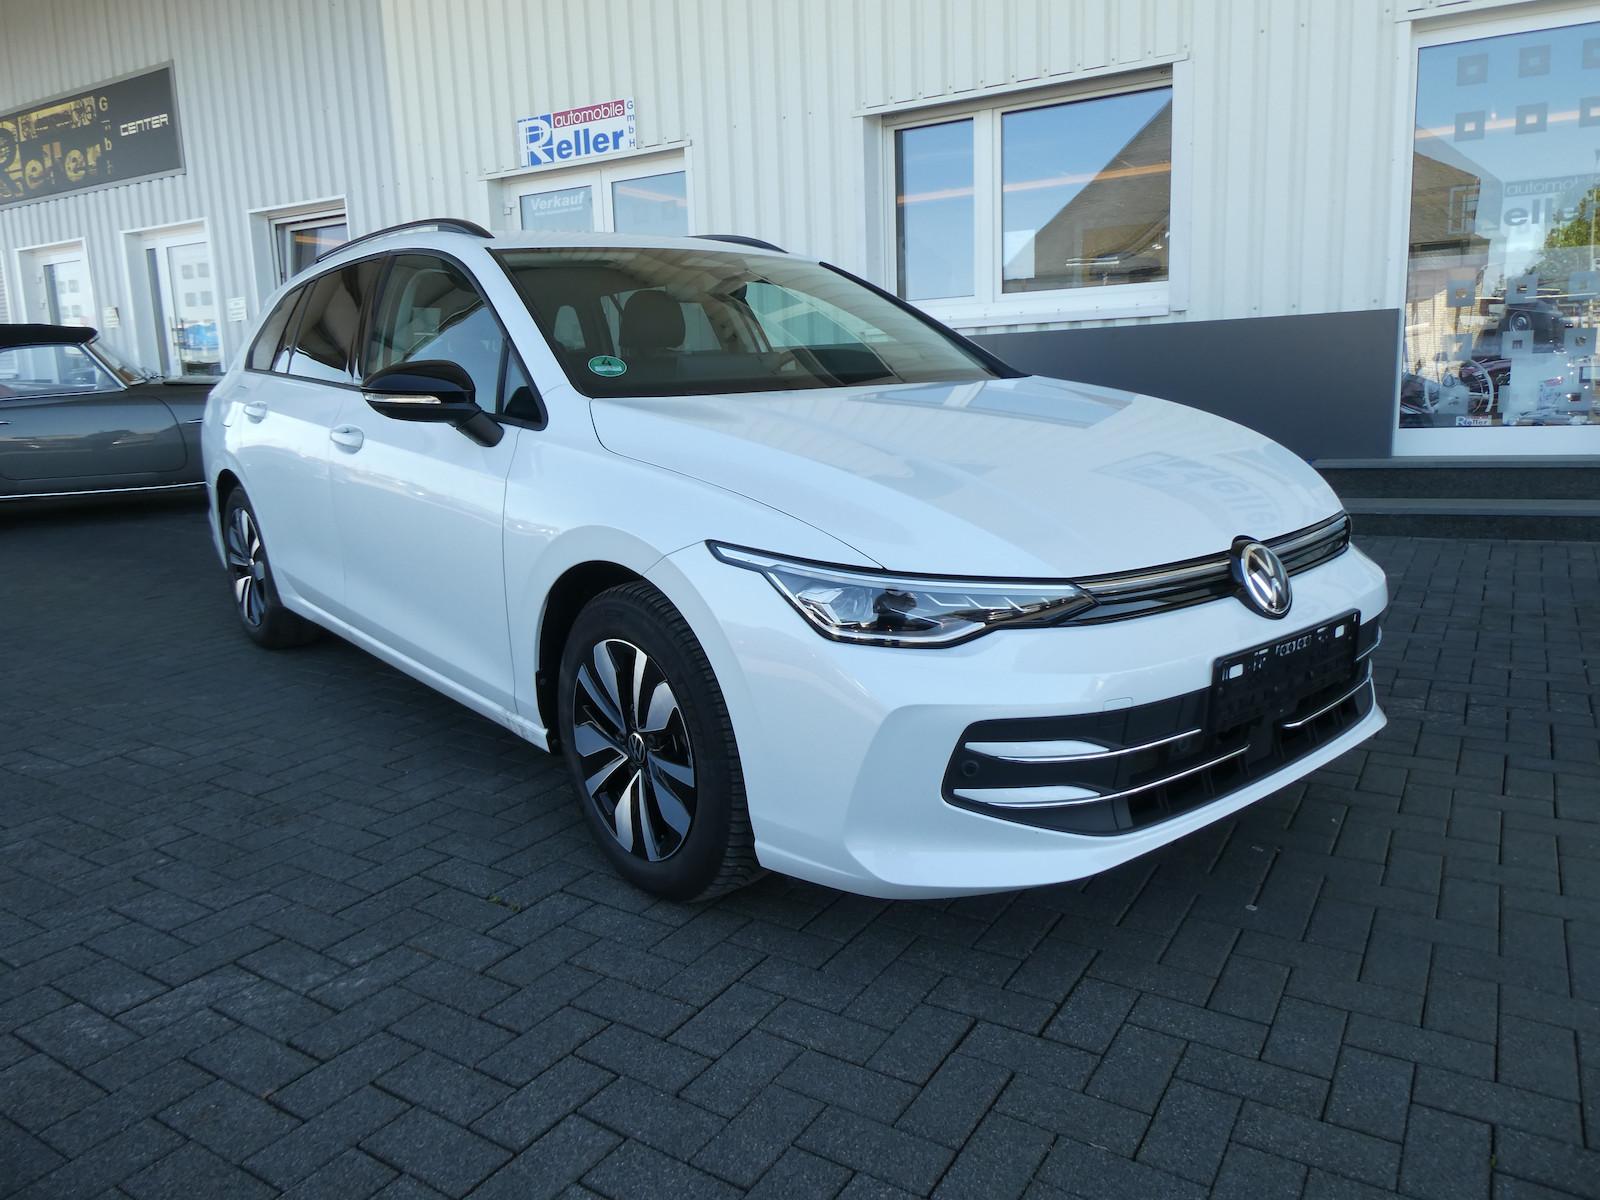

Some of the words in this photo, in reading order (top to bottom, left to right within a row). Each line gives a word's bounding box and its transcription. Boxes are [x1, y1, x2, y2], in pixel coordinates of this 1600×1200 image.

[120, 114, 169, 136] CENTER
[554, 103, 624, 128] automobile
[626, 100, 636, 148] GmbH
[518, 116, 625, 167] Reller
[530, 191, 585, 211] Verkauf
